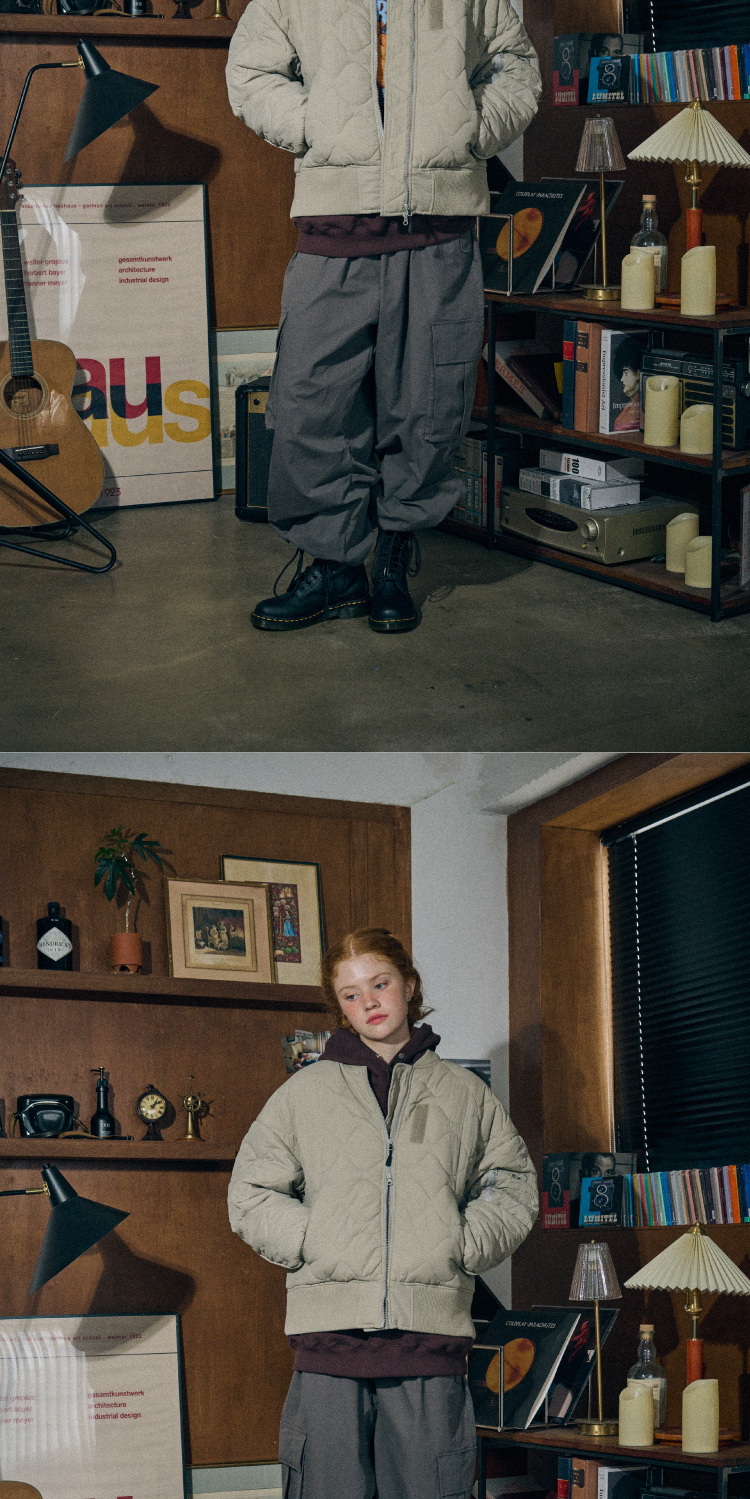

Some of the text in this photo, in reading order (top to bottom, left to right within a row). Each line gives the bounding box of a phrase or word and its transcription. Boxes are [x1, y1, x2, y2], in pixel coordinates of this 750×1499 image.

[118, 256, 172, 264] gesamtkunstwerk
[571, 457, 580, 474] 100
[88, 1390, 145, 1399] gesamtkunstwerk
